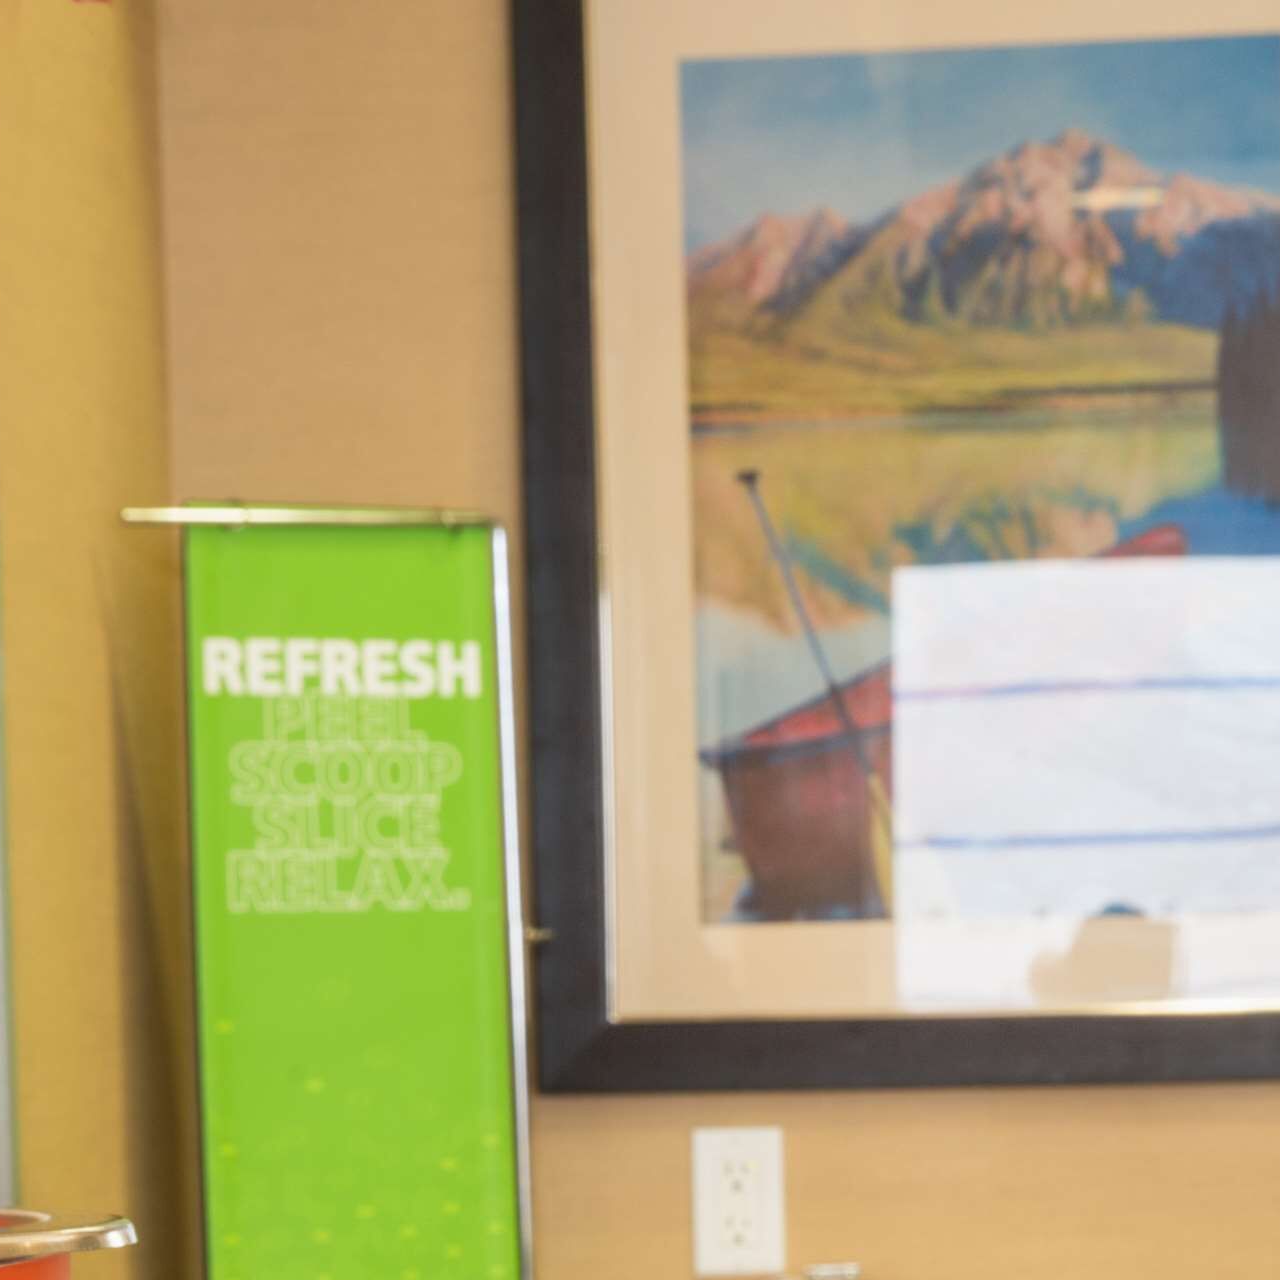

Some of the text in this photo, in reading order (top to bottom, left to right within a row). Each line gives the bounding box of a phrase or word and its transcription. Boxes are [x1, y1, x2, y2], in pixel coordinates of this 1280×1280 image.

[201, 635, 483, 698] REFRESH
[227, 738, 464, 806] SCOOP
[251, 794, 444, 857] SLICE
[225, 849, 472, 914] RELAX.
